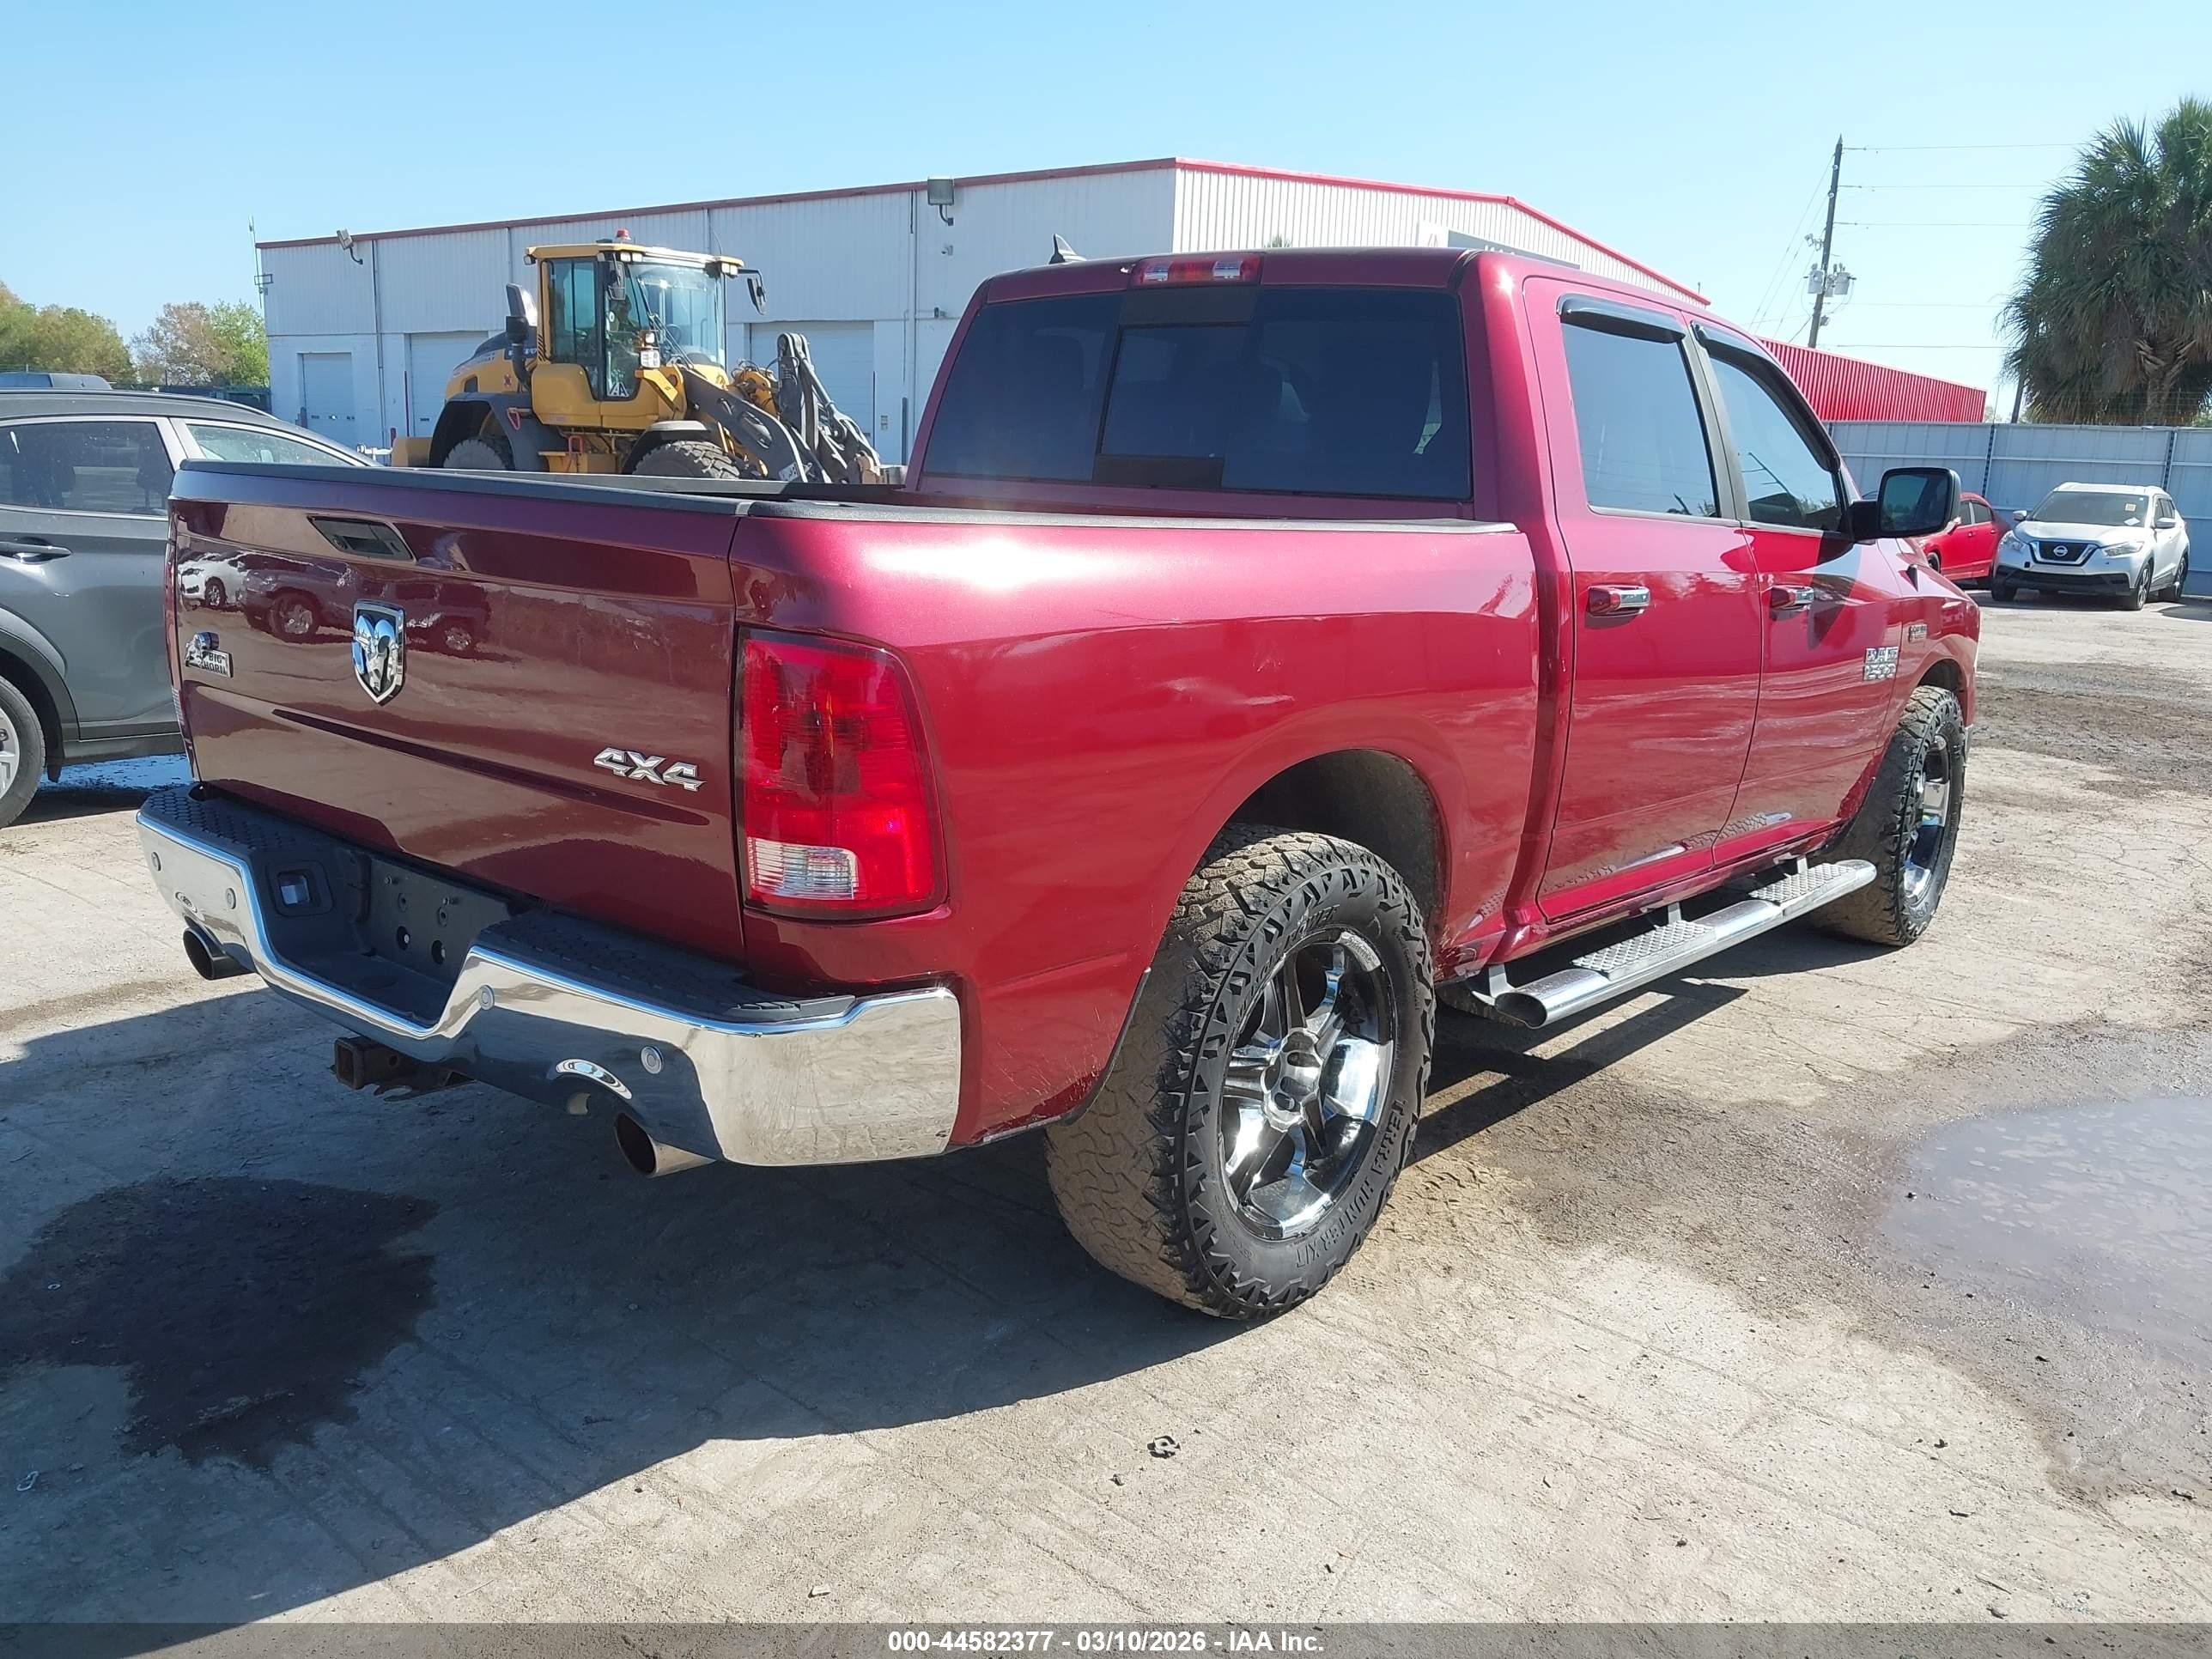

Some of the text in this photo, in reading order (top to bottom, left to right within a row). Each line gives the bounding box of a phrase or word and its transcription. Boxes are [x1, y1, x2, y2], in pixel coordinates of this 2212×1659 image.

[204, 660, 226, 674] HORN
[209, 652, 223, 664] BIG
[1370, 1098, 1408, 1176] TERRA
[1320, 1176, 1375, 1245] HUNTER
